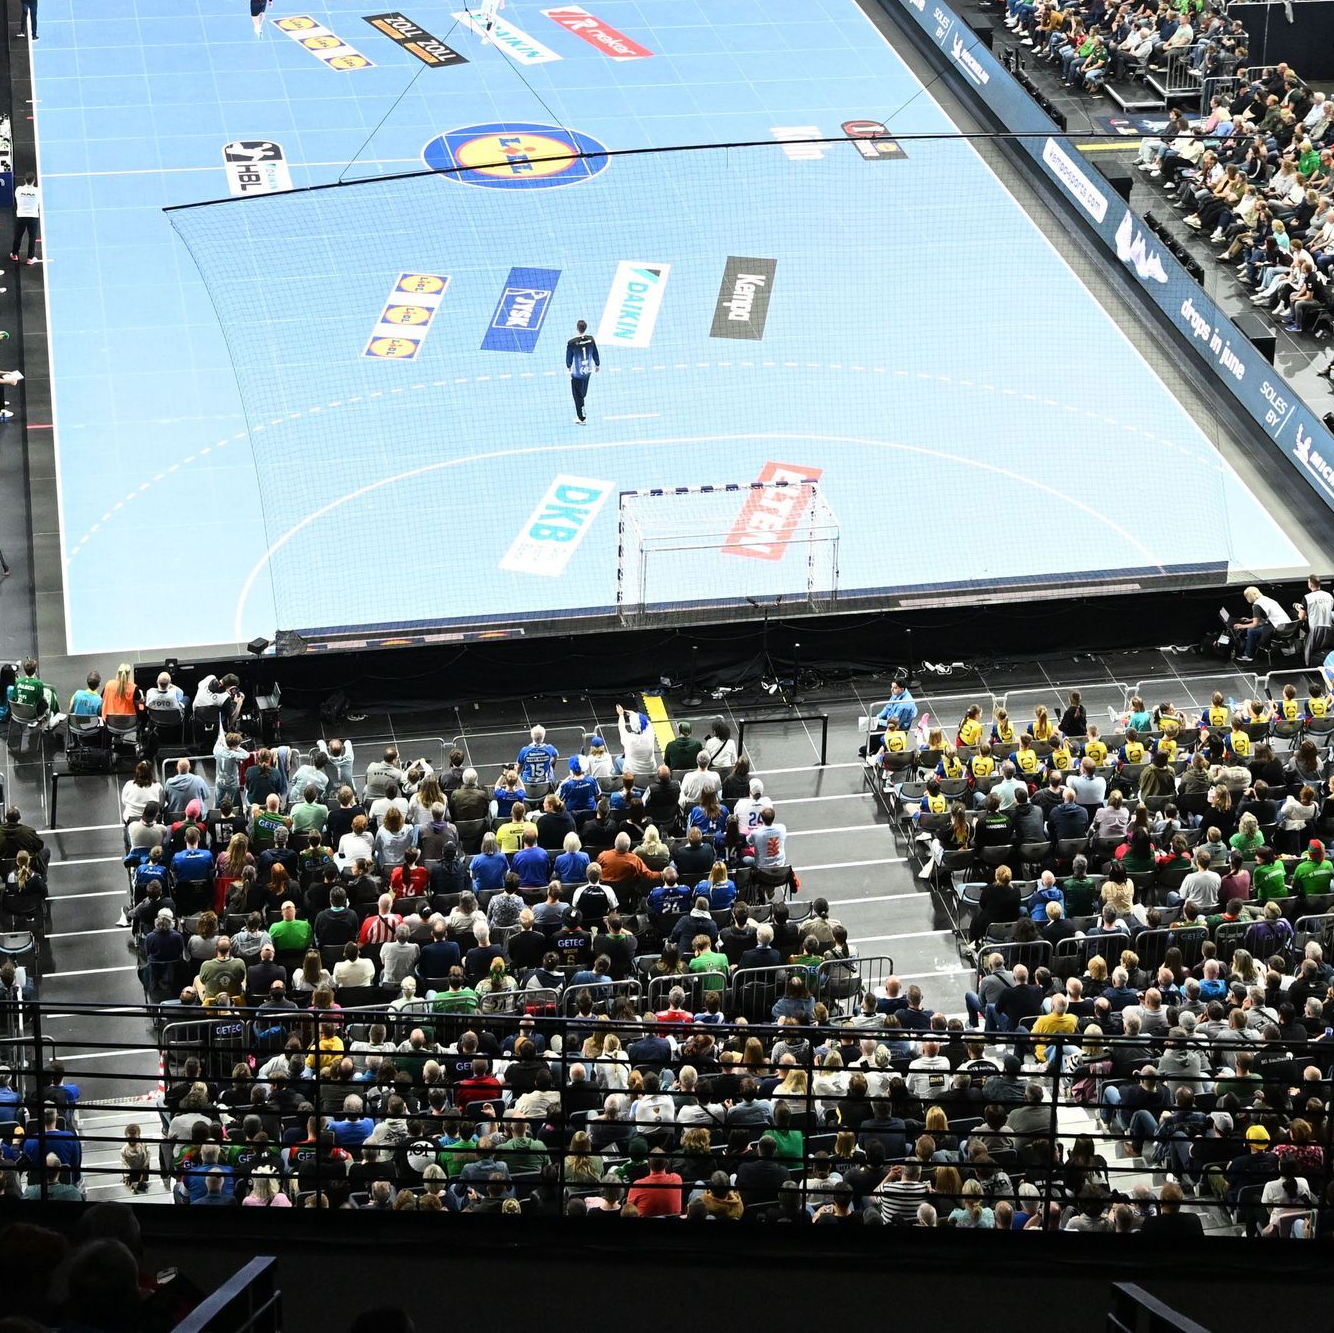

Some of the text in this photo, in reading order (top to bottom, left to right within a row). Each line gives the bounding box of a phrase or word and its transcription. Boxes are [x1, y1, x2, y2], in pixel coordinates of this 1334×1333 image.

[384, 16, 423, 38] ZOLL
[933, 7, 951, 29] SOLES
[417, 39, 456, 62] ZOLL
[235, 164, 262, 191] HBL
[1048, 145, 1102, 213] kempa-sports.com
[414, 276, 430, 292] LIDL
[722, 273, 766, 321] Kempa
[401, 307, 416, 323] LIDL
[505, 297, 536, 327] JYSK
[612, 280, 649, 340] DAIKIN
[385, 339, 402, 356] LIDL
[1180, 297, 1246, 382] drops in june
[1259, 381, 1288, 415] SOLES
[1265, 409, 1281, 428] BY
[529, 483, 604, 544] DKB
[530, 762, 545, 777] 15
[557, 938, 585, 948] GETEC
[216, 1024, 242, 1036] GETEC
[455, 1062, 473, 1071] GET
